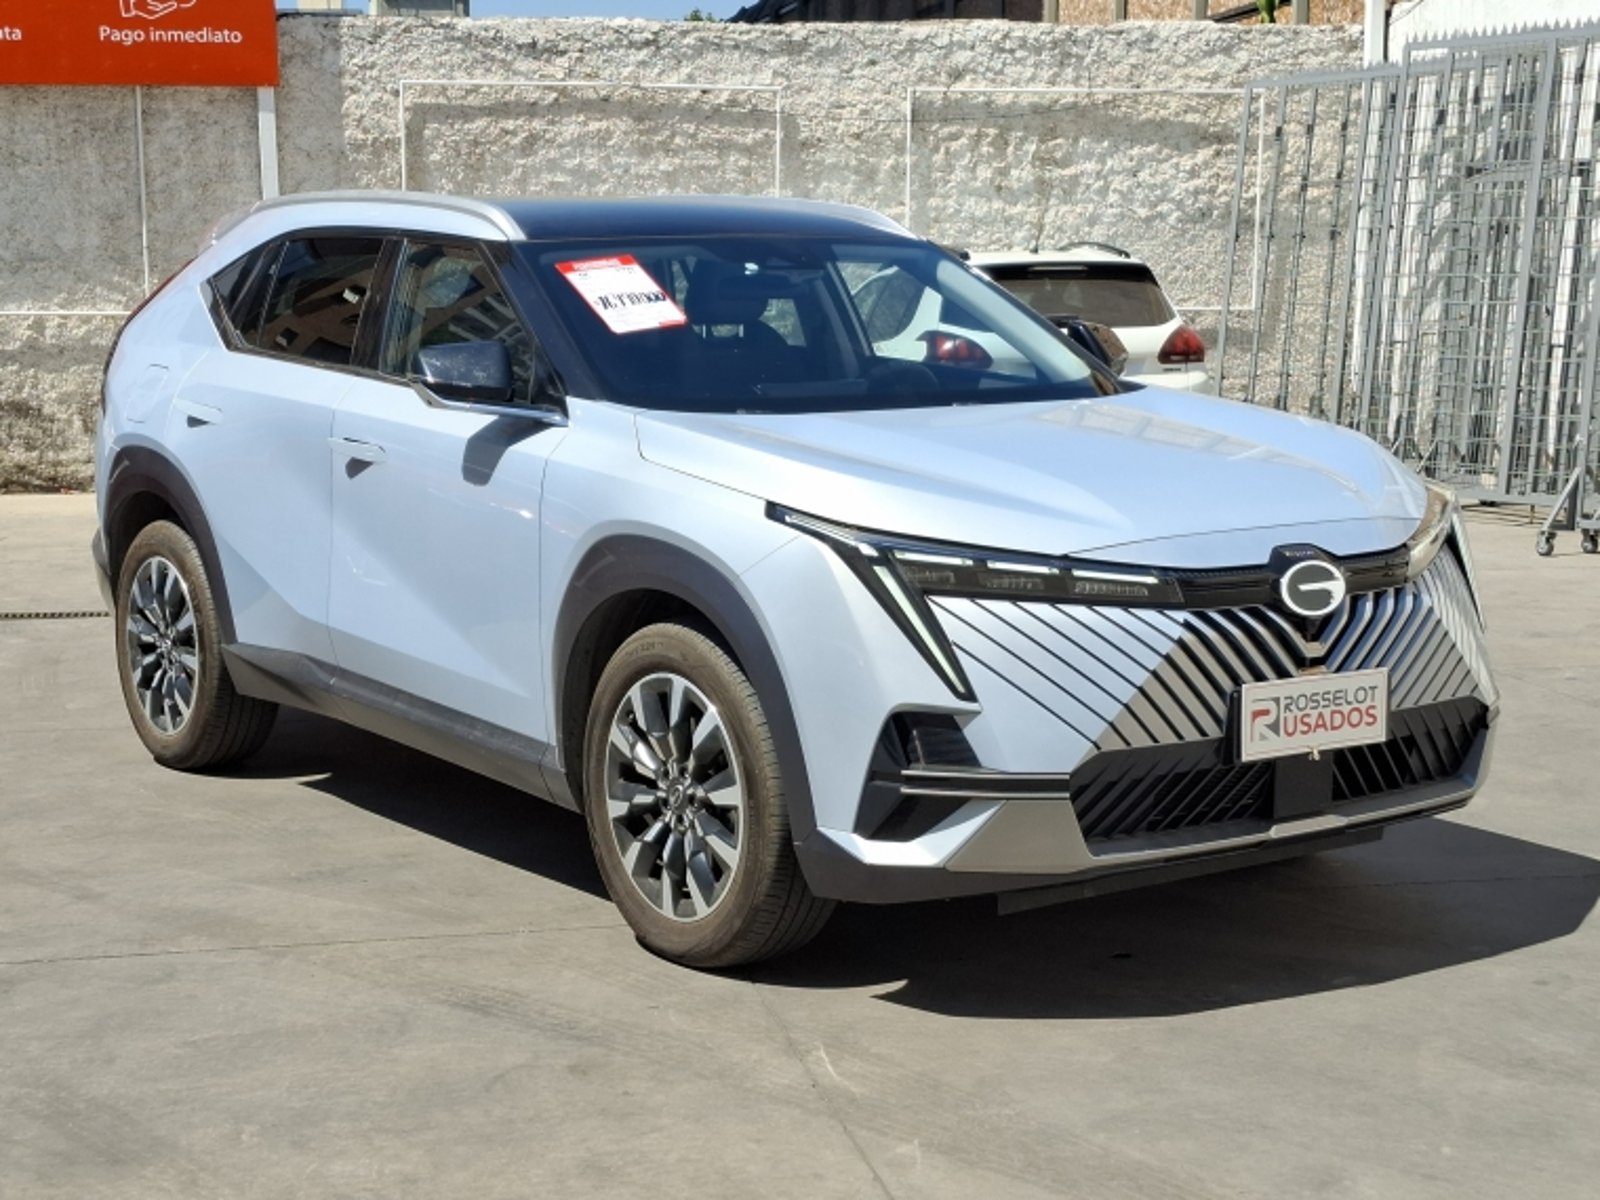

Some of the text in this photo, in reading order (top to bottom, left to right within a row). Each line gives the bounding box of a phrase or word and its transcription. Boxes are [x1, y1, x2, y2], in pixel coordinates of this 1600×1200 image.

[99, 26, 242, 45] Pago inmediato
[1283, 685, 1378, 713] ROSSELOT
[1283, 705, 1377, 737] USADOS
